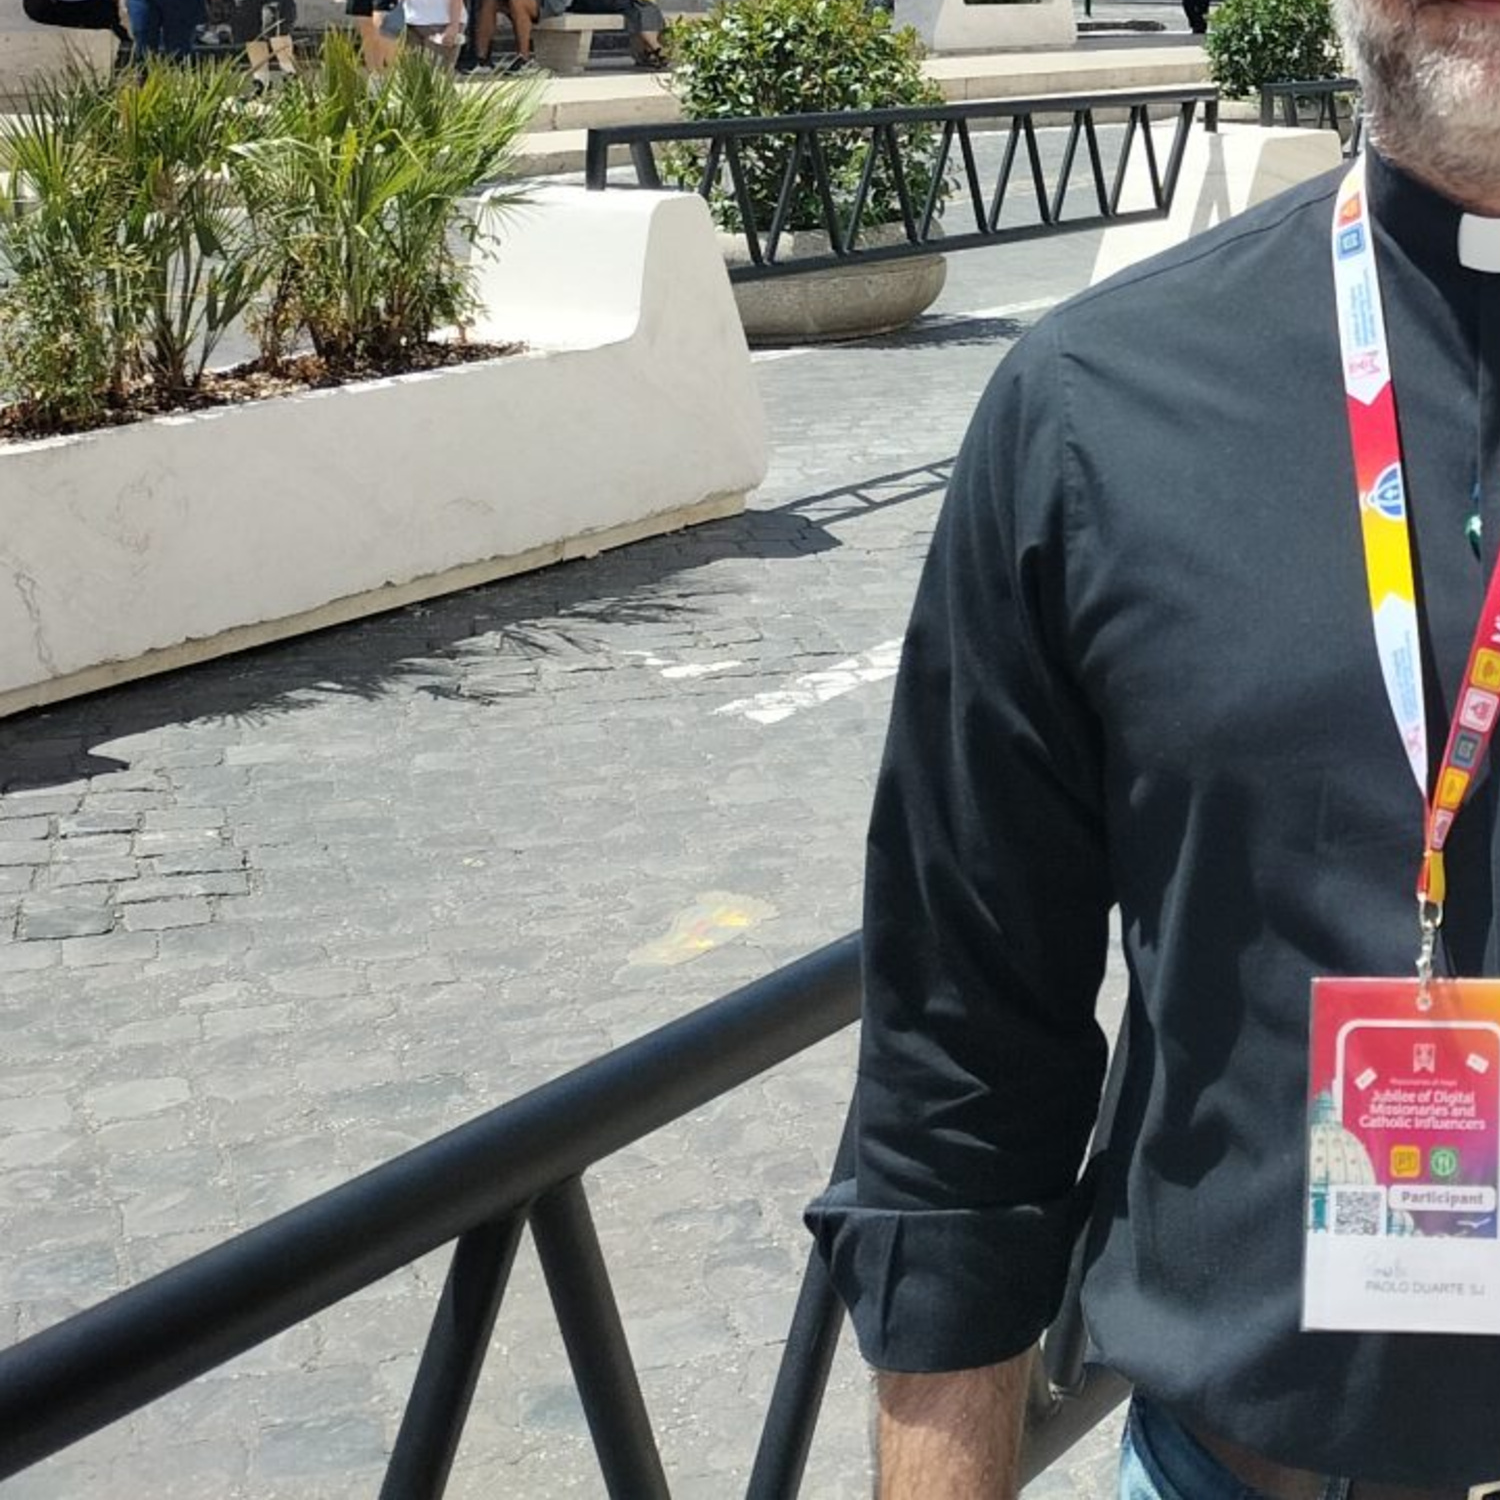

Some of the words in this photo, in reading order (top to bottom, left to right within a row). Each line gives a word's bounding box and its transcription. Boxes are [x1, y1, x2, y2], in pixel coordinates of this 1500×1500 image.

[1371, 1090, 1415, 1103] Jubilee
[1417, 1090, 1432, 1103] of
[1433, 1090, 1475, 1107] Digital
[1369, 1103, 1448, 1117] Missionaries
[1450, 1105, 1476, 1117] and
[1359, 1115, 1412, 1129] Catholic
[1414, 1116, 1485, 1130] Influencers
[1401, 1191, 1484, 1208] Participant
[1412, 1281, 1464, 1296] DUARTE
